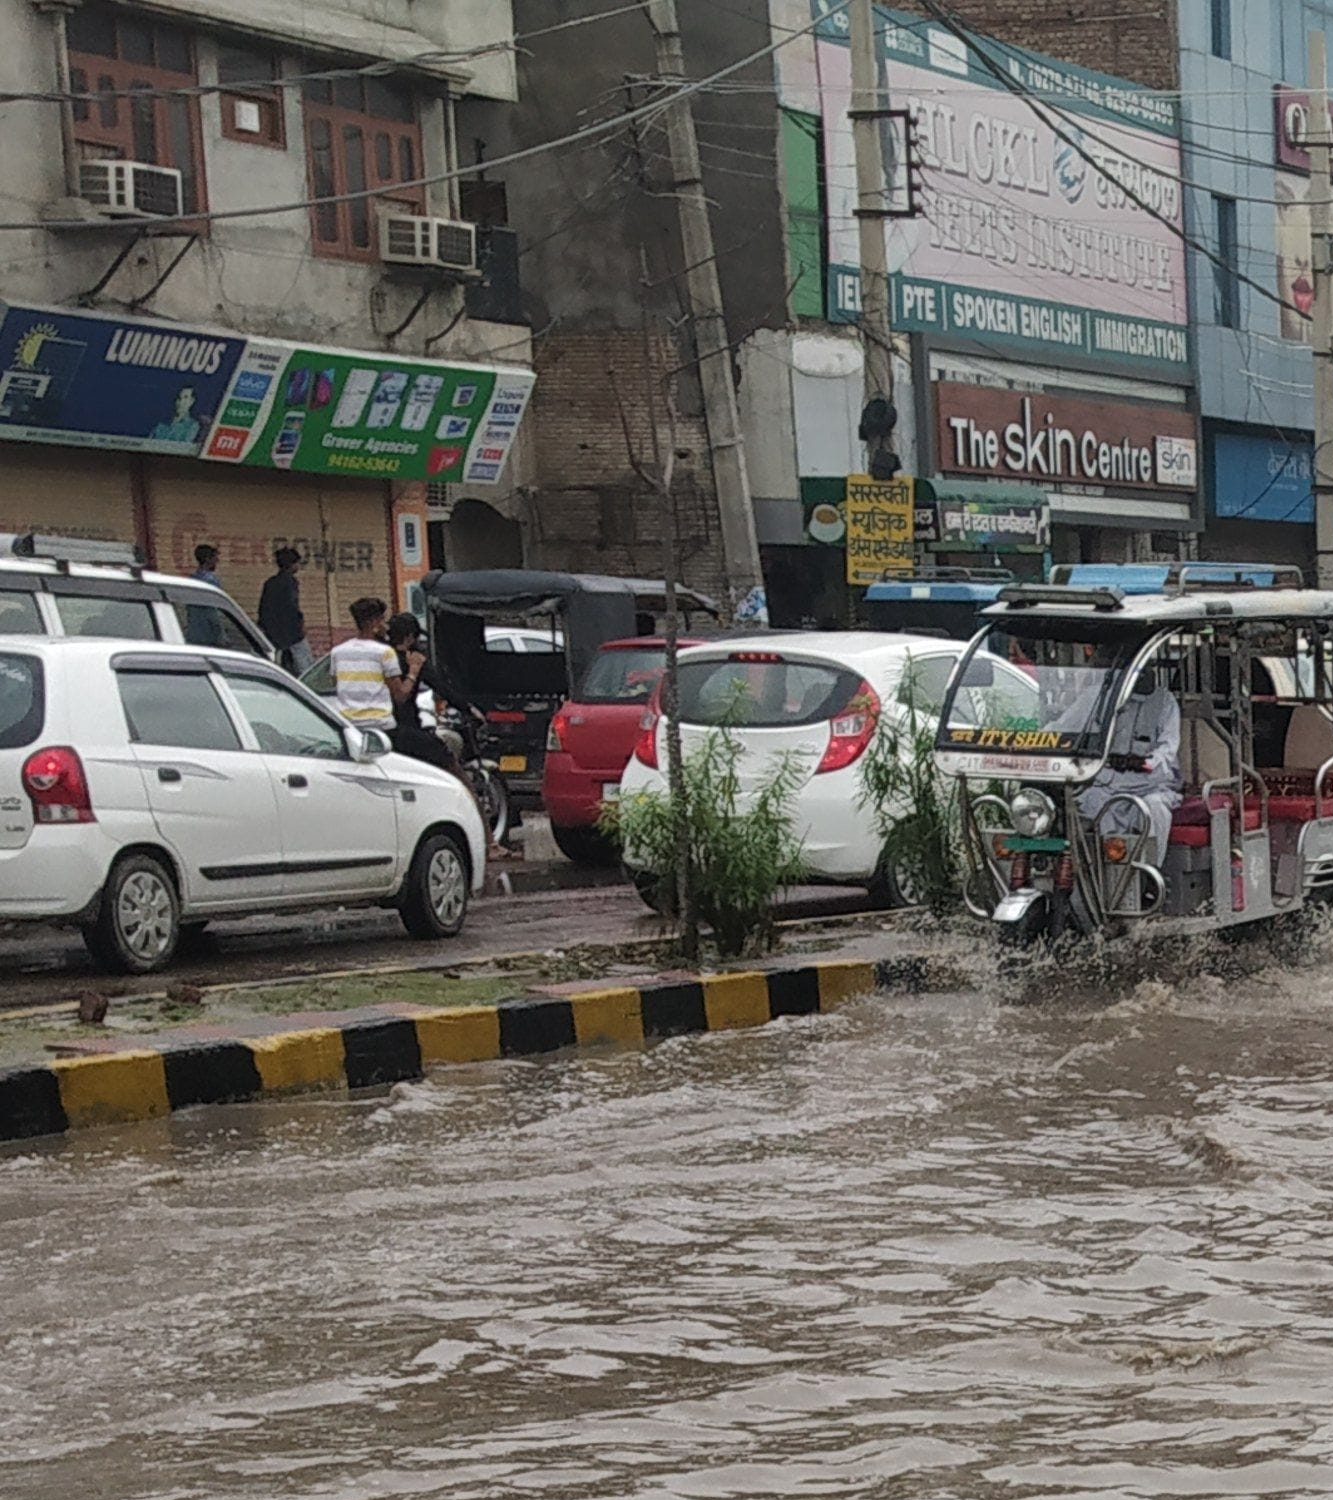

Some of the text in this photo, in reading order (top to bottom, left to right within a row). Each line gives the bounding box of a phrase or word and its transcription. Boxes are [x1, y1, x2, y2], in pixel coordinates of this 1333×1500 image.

[1027, 216, 1175, 293] INSTITUTE
[105, 329, 227, 375] LUMINOUS
[902, 285, 936, 322] PTE
[953, 292, 1017, 334] SPOKEN
[1020, 305, 1083, 346] ENGLISH
[1095, 317, 1188, 363] IMMIGRATION
[950, 416, 999, 468] The
[1081, 430, 1151, 483] Centre
